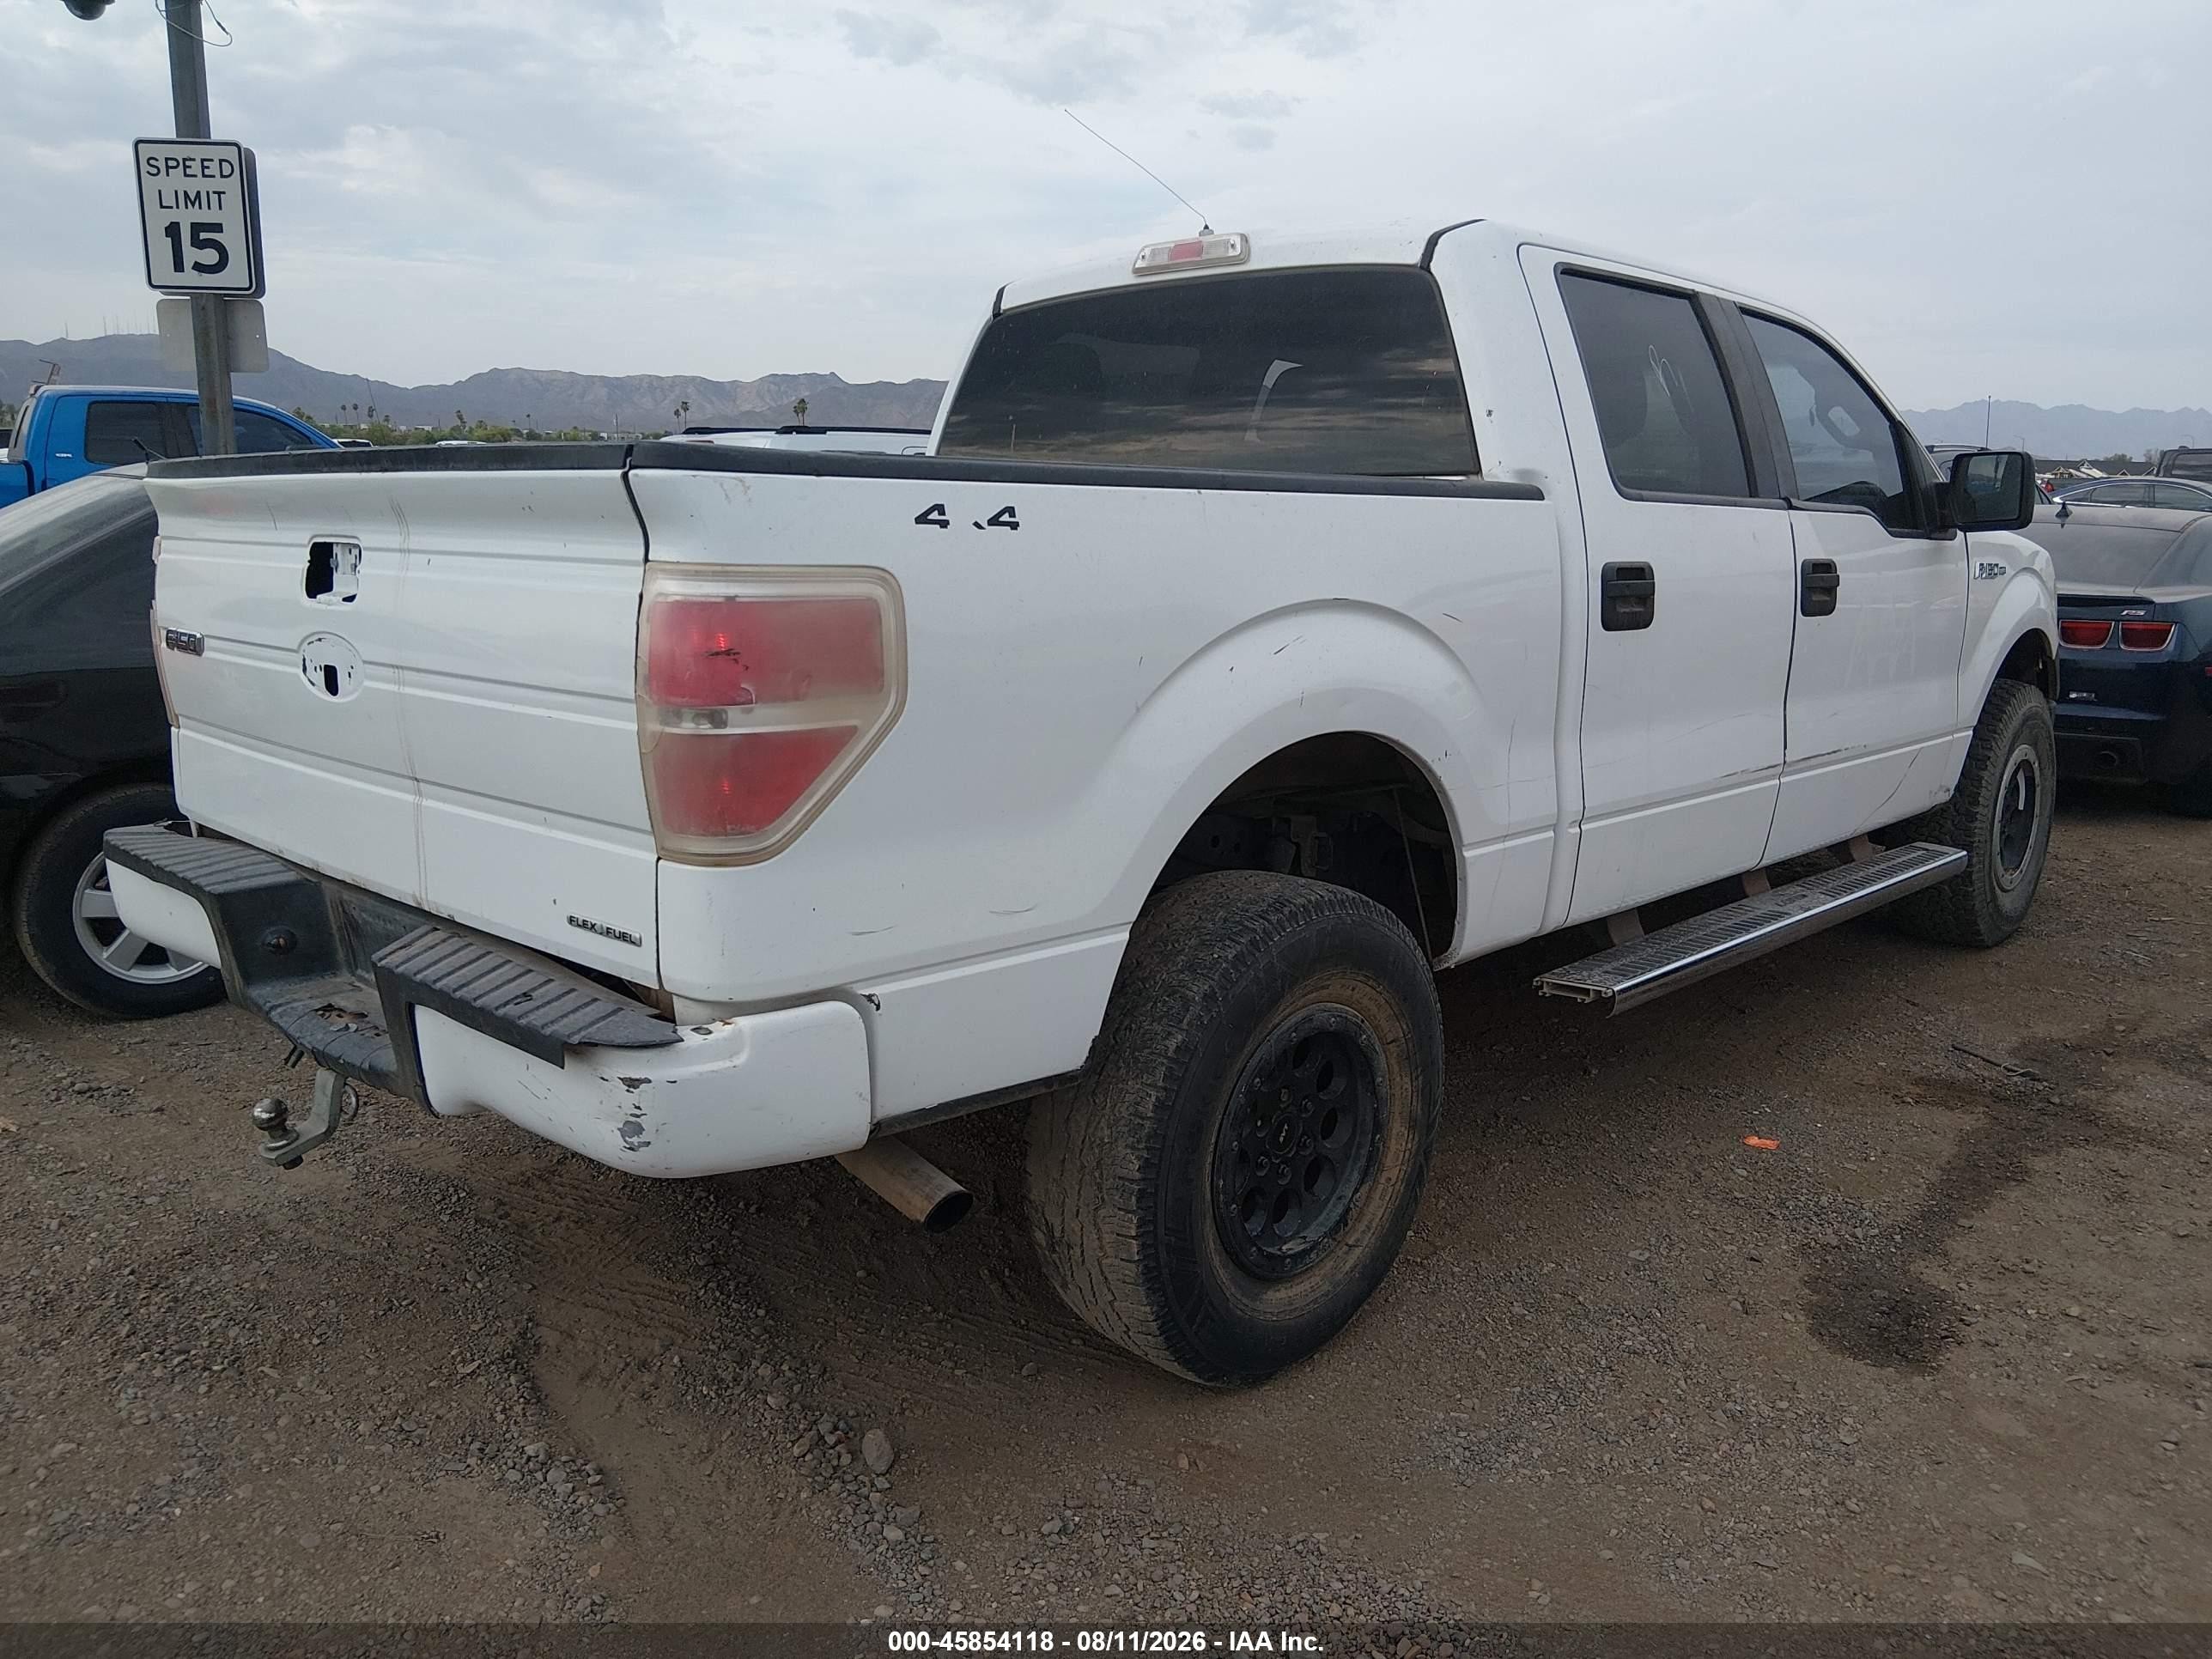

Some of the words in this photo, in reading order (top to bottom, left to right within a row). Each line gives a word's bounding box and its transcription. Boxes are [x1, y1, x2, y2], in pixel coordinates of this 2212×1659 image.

[145, 156, 234, 179] SPEED
[158, 189, 226, 211] LIMIT
[164, 221, 229, 275] 15
[568, 915, 599, 933] FLEX
[605, 927, 638, 945] FUEL
